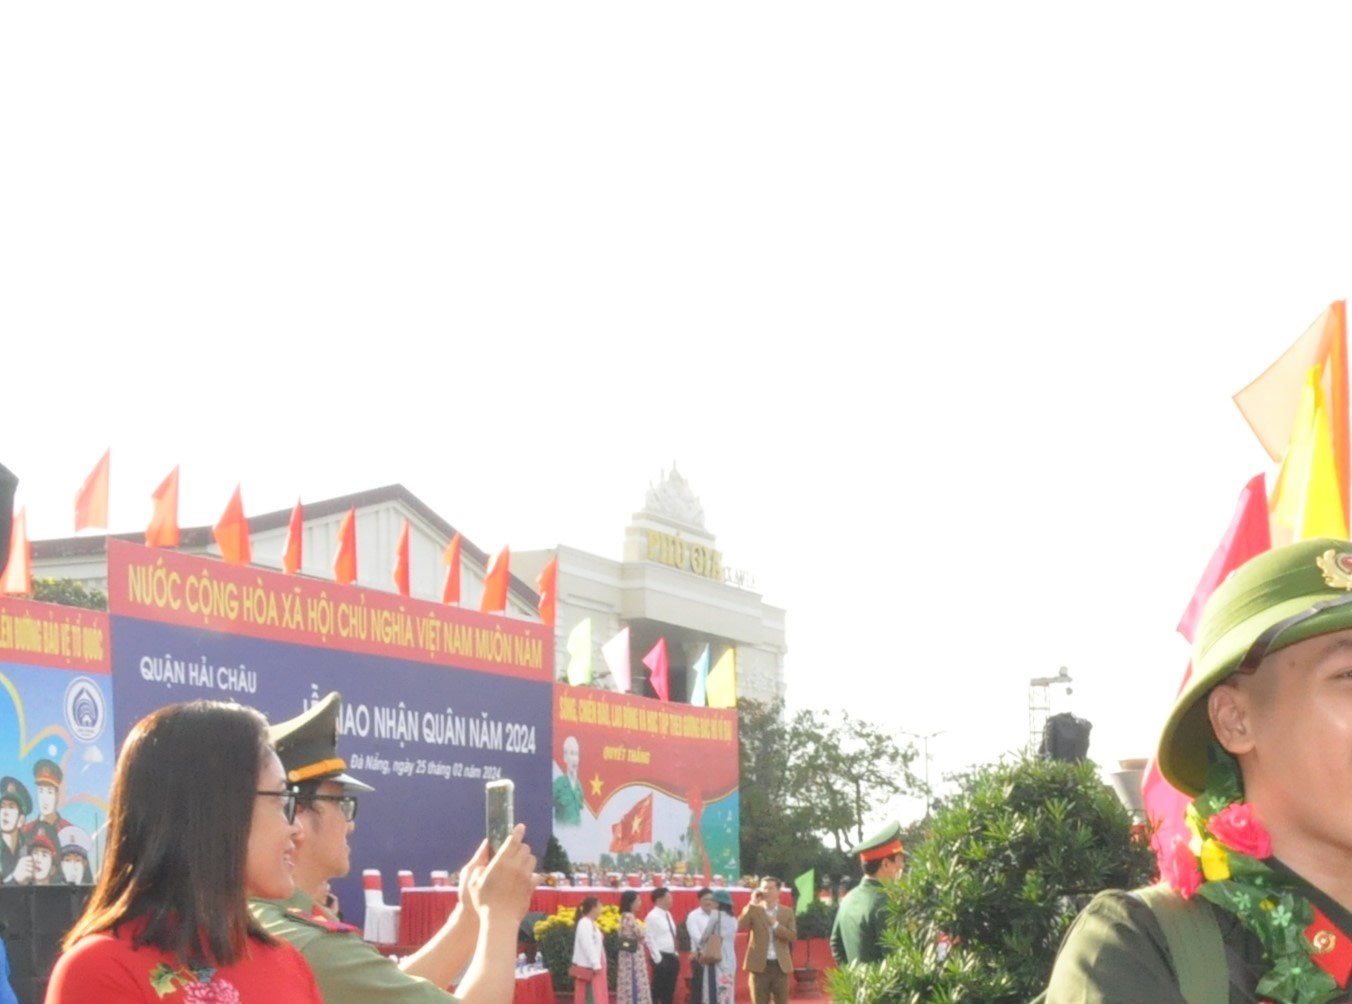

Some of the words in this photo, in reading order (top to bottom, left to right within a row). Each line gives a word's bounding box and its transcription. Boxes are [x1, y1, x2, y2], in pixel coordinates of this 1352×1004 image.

[128, 557, 182, 611] NƯỚC
[186, 568, 239, 624] CỘNG
[243, 577, 280, 626] HÒA
[282, 587, 304, 630] XÃ
[308, 591, 334, 642] HỘI
[337, 593, 368, 640] CHỦ
[371, 606, 415, 648] NGHĨA
[416, 611, 441, 659] VIỆT
[443, 623, 473, 658] NAM
[475, 625, 512, 666] MUÔN
[514, 630, 543, 669] NĂM
[140, 654, 185, 688] QUẬN
[189, 656, 214, 689] HẢI
[217, 664, 257, 694] CHÂU
[374, 702, 418, 748] NHẬN
[422, 708, 466, 748] QUÂN
[469, 712, 502, 751] NĂM
[505, 723, 536, 754] 2024
